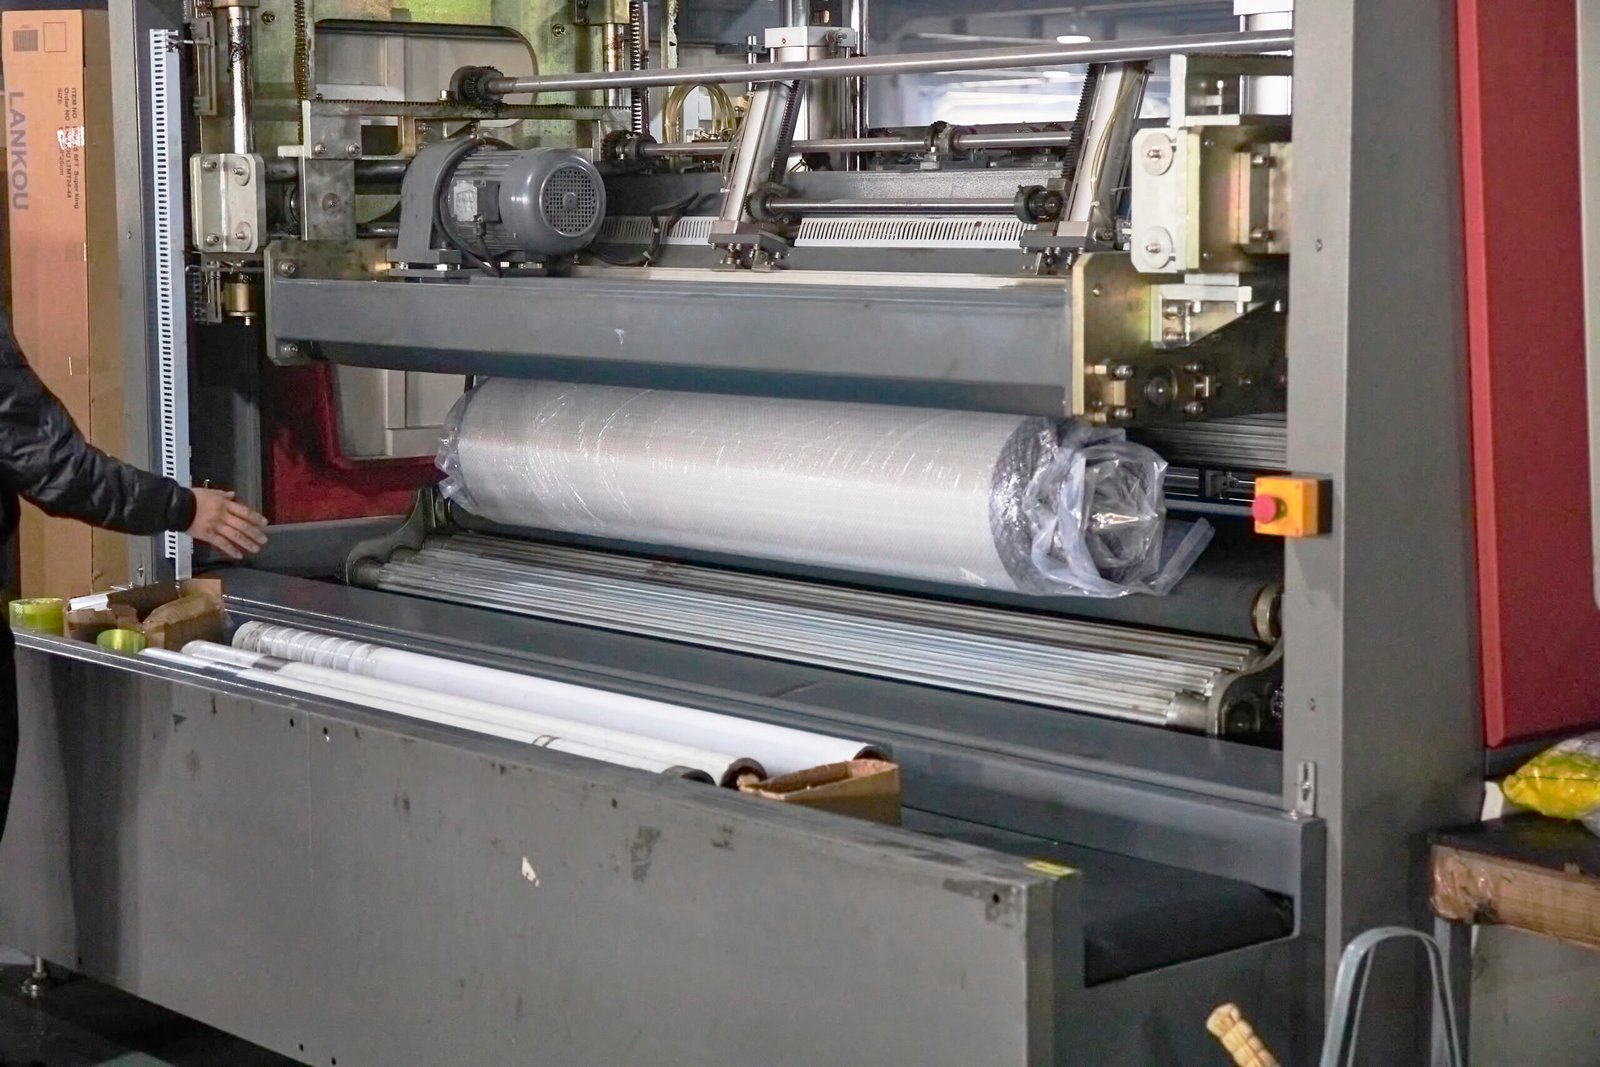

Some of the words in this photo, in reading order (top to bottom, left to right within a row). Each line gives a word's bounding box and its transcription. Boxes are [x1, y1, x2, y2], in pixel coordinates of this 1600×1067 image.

[65, 109, 71, 121] NO
[72, 107, 78, 119] NO
[9, 92, 29, 210] LANKOU
